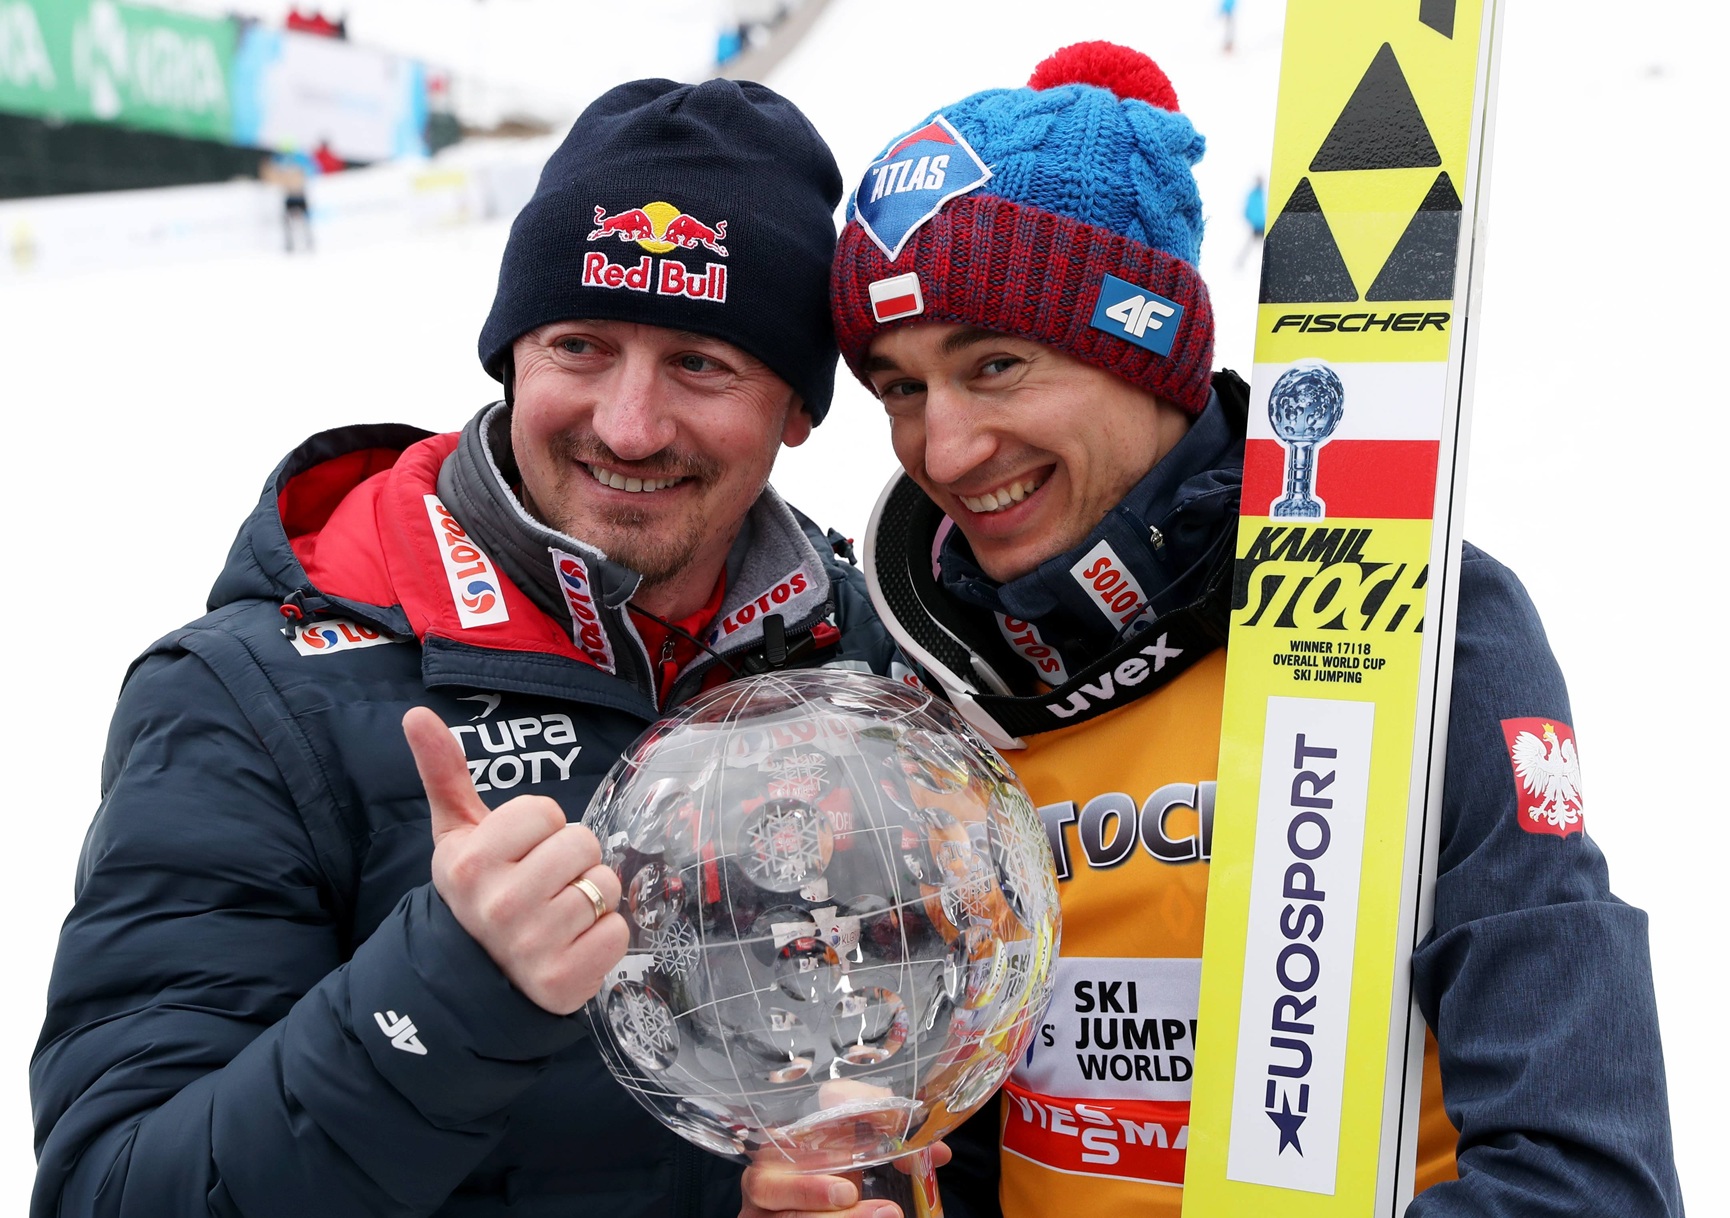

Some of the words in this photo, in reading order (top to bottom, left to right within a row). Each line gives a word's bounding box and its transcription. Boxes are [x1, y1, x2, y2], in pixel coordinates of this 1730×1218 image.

[870, 154, 950, 204] ATLAS
[581, 251, 653, 293] Red
[656, 258, 729, 304] Bull
[1105, 294, 1176, 339] 4F
[1271, 312, 1452, 334] FISCHER
[1243, 526, 1374, 564] KAMIL
[722, 572, 808, 636] LOTOS
[1230, 560, 1429, 634] STOCH
[1004, 613, 1061, 674] OTOS
[1273, 653, 1319, 667] OVERALL
[1322, 656, 1360, 669] WORLD
[1363, 658, 1386, 669] CUP
[1290, 640, 1333, 653] WINNER
[1045, 631, 1185, 719] uvex
[1293, 669, 1311, 681] SKI
[1314, 670, 1362, 683] JUMPING
[466, 747, 582, 793] ZOTY
[1264, 732, 1338, 1116] EUROSPORT
[1074, 980, 1138, 1014] SKI
[373, 1009, 428, 1056] 4F
[1075, 1017, 1198, 1051] JUMPI
[1076, 1053, 1193, 1082] WORLD
